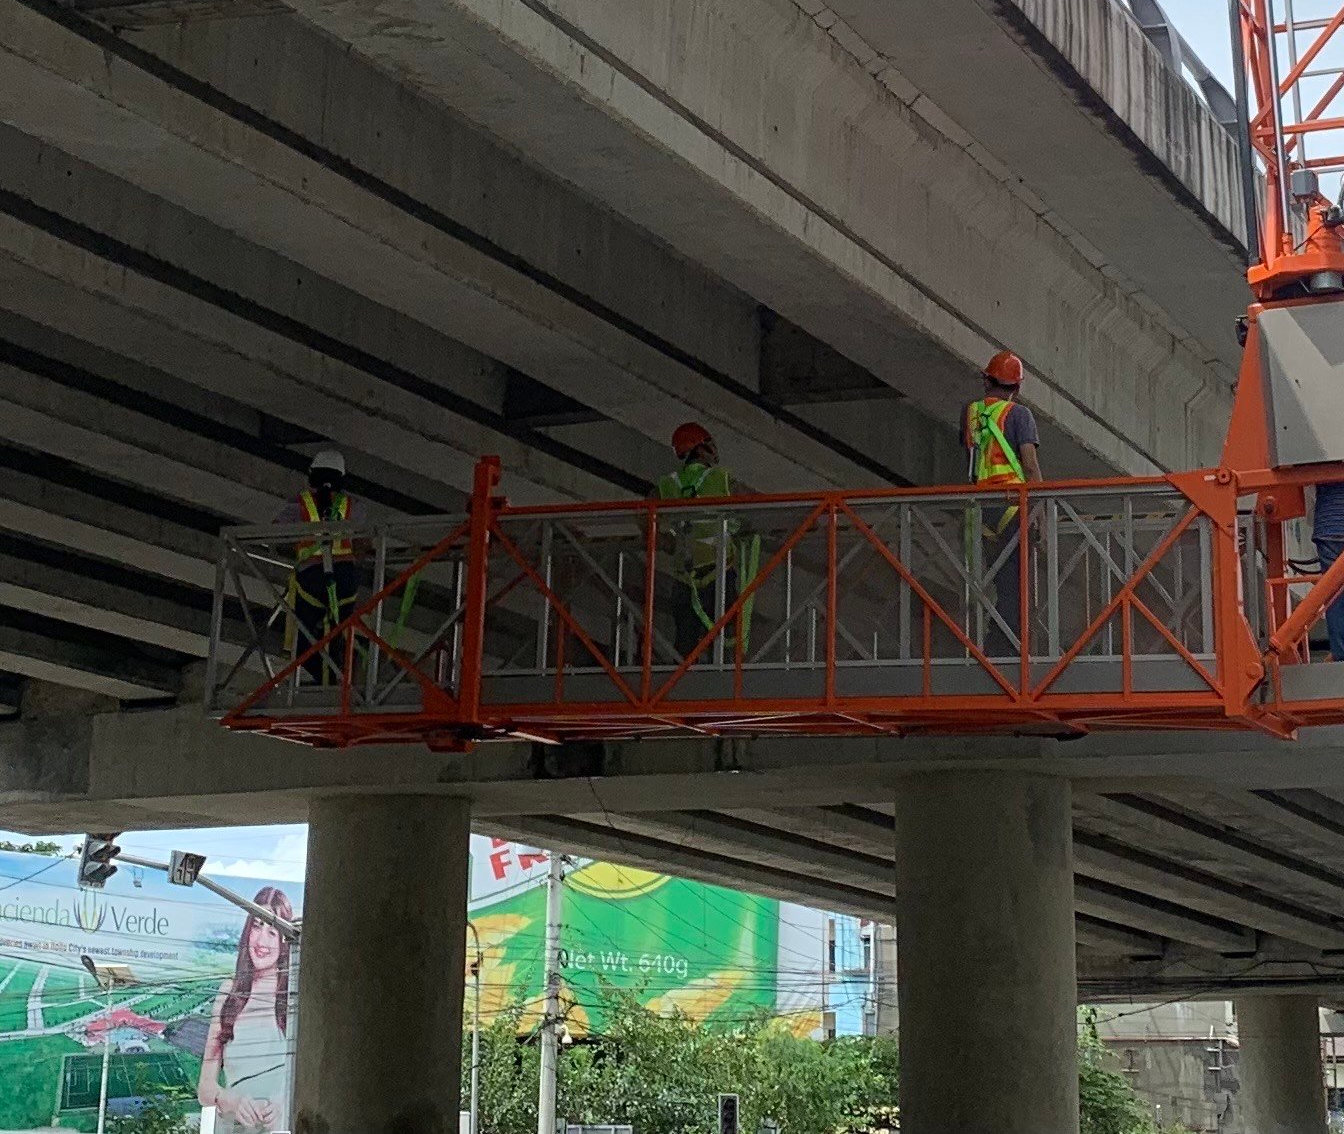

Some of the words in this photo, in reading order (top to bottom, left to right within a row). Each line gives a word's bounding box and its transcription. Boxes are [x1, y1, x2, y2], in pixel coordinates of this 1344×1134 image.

[111, 906, 169, 936] Verde
[558, 949, 595, 970] Net
[600, 951, 633, 972] Wt.
